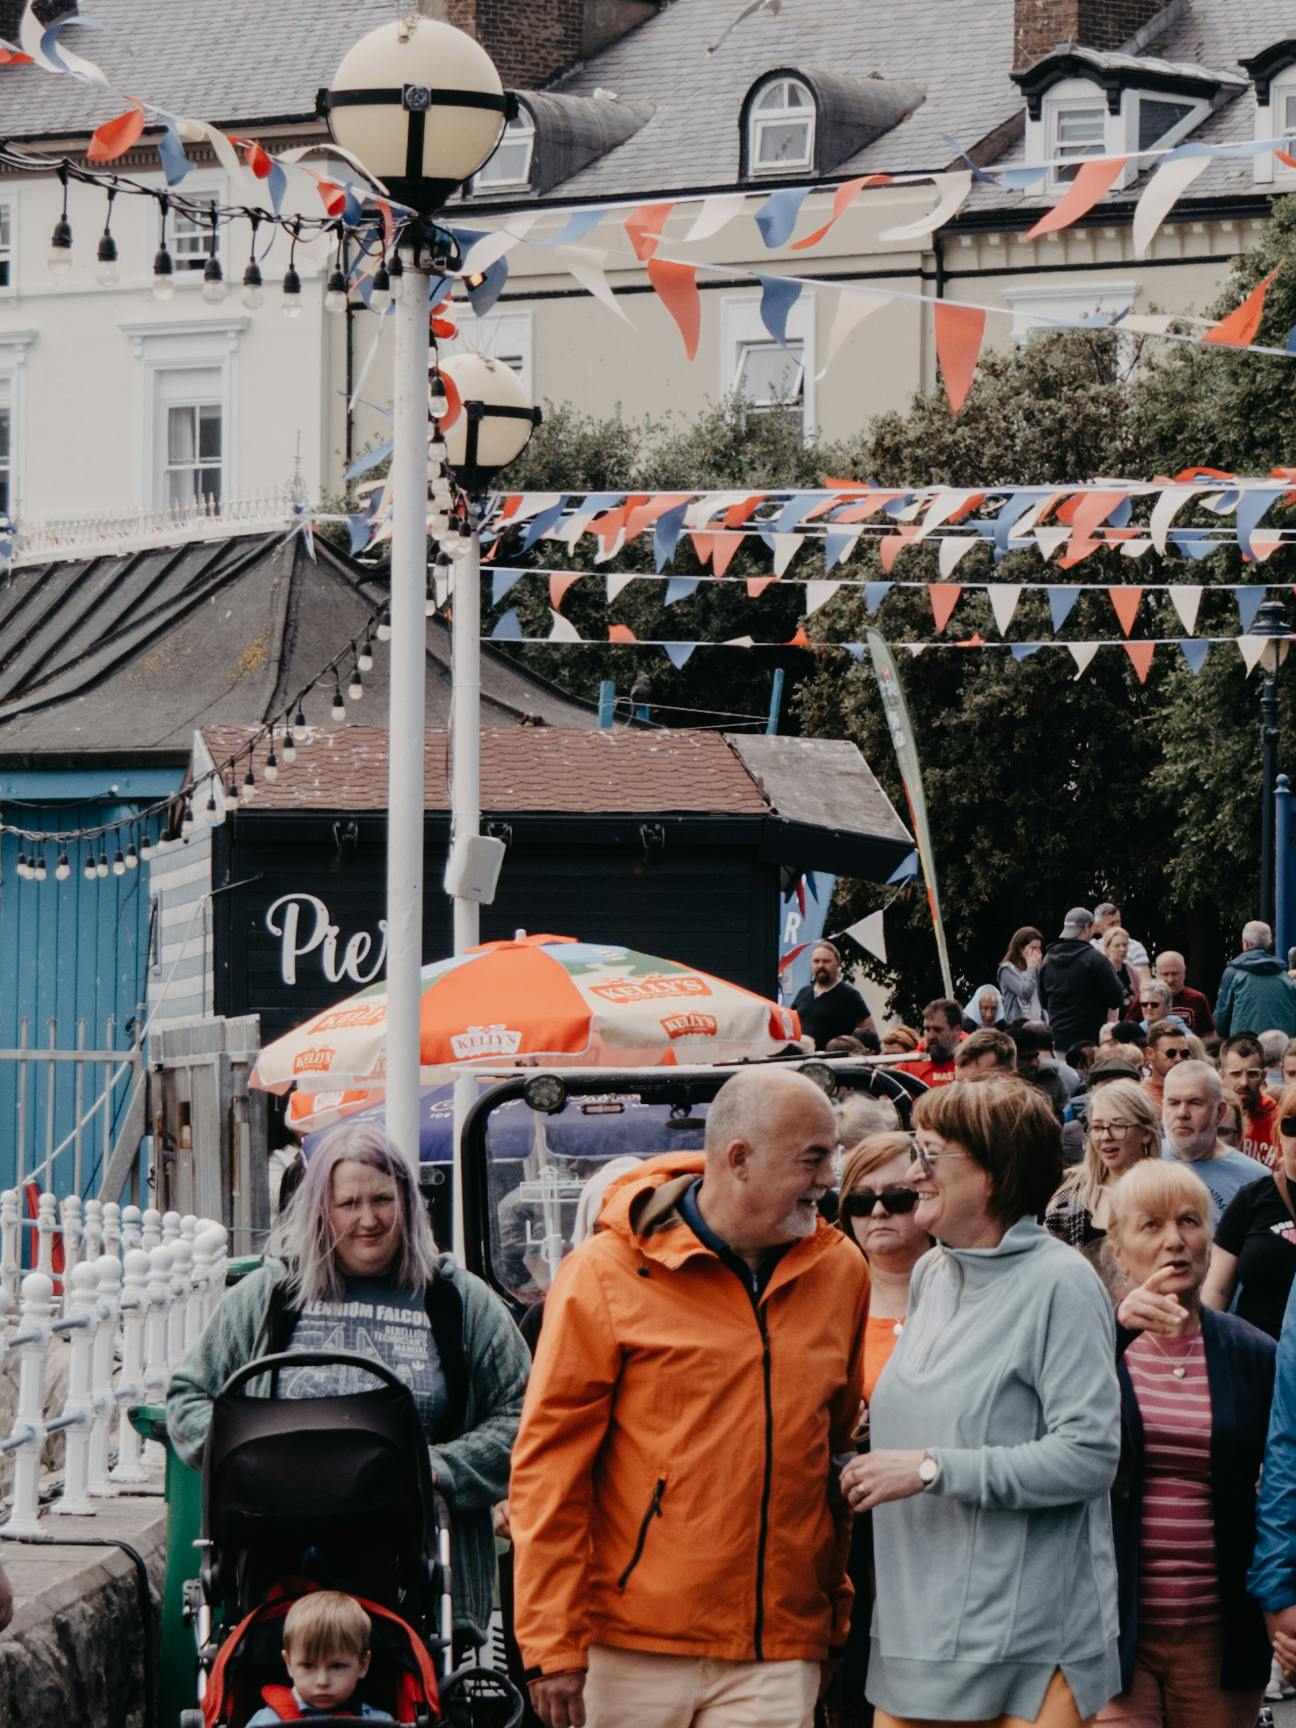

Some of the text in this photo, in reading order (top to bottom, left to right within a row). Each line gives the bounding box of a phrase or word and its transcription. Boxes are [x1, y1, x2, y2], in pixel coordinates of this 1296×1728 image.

[597, 977, 702, 1000] KELLY'S
[667, 1015, 715, 1030] KELLY'S
[457, 1032, 517, 1049] KELLY'S
